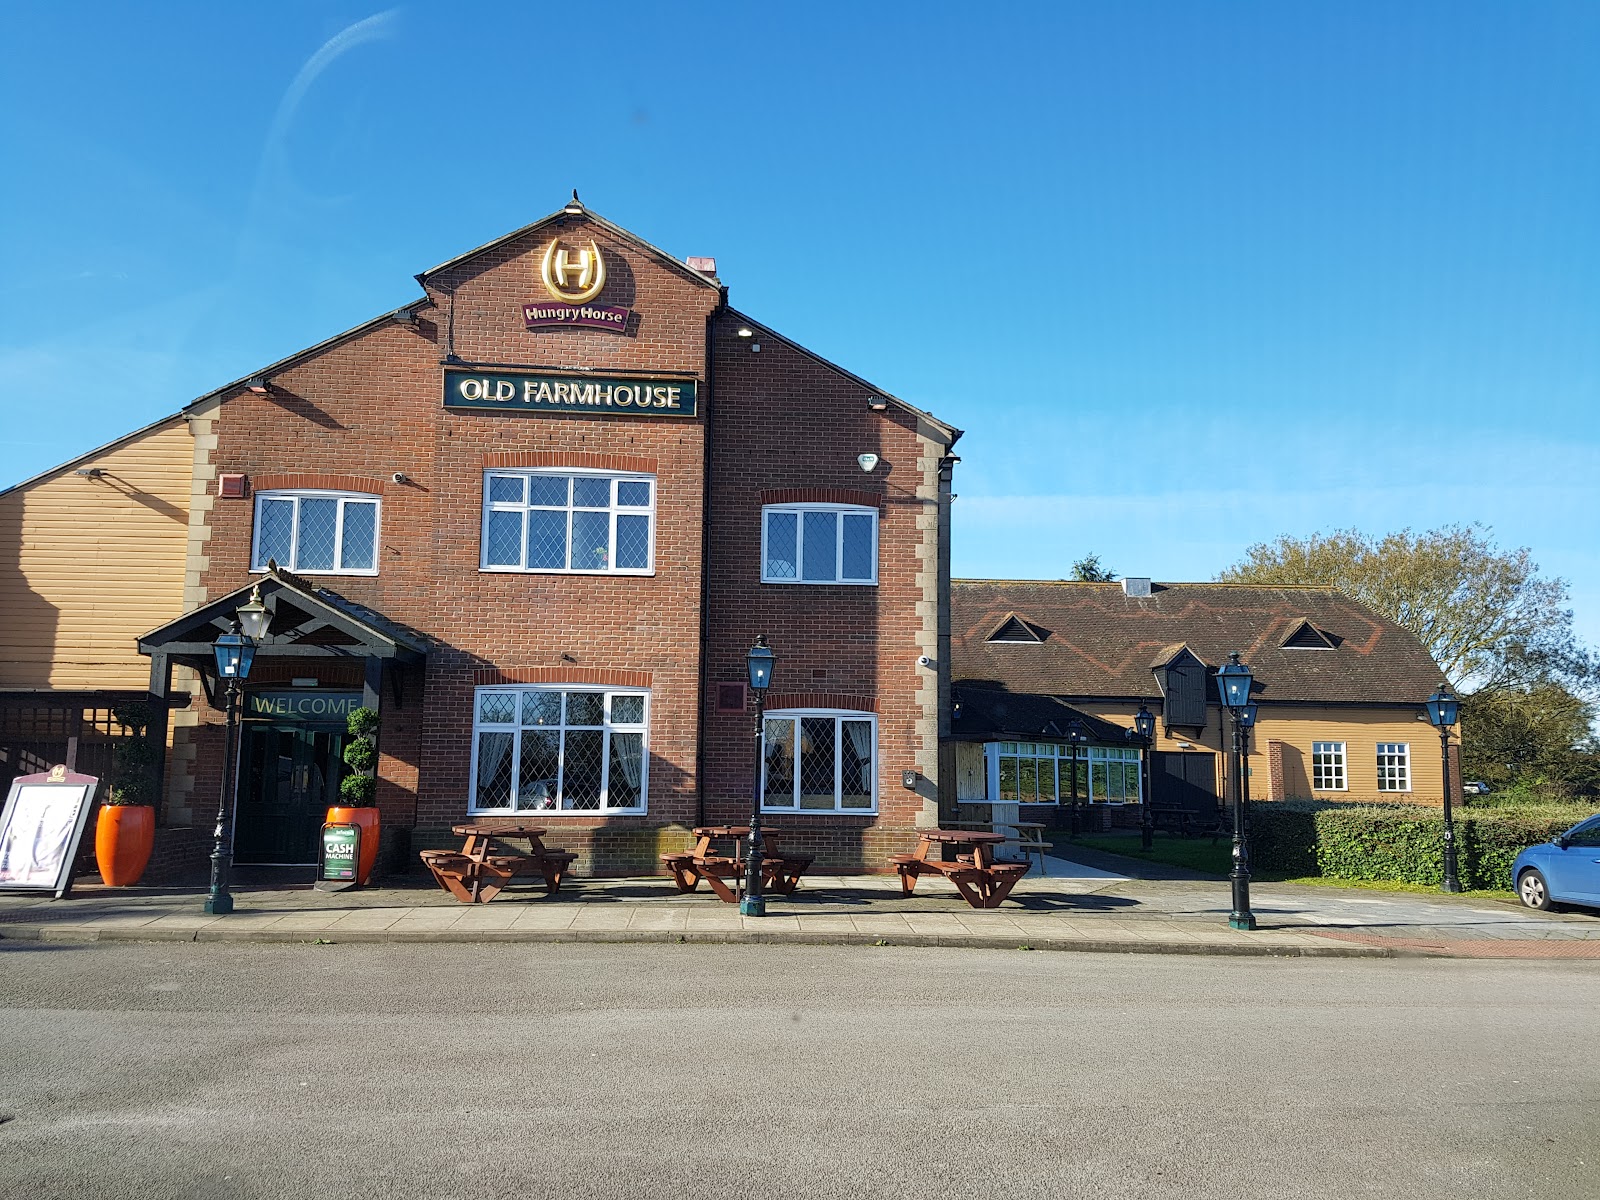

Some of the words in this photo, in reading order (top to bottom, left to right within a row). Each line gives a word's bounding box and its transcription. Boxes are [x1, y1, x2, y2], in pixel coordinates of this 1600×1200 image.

[460, 379, 516, 401] OLD
[524, 381, 681, 409] FARMHOUSE
[255, 697, 358, 714] WELCOME
[325, 843, 354, 854] CASH
